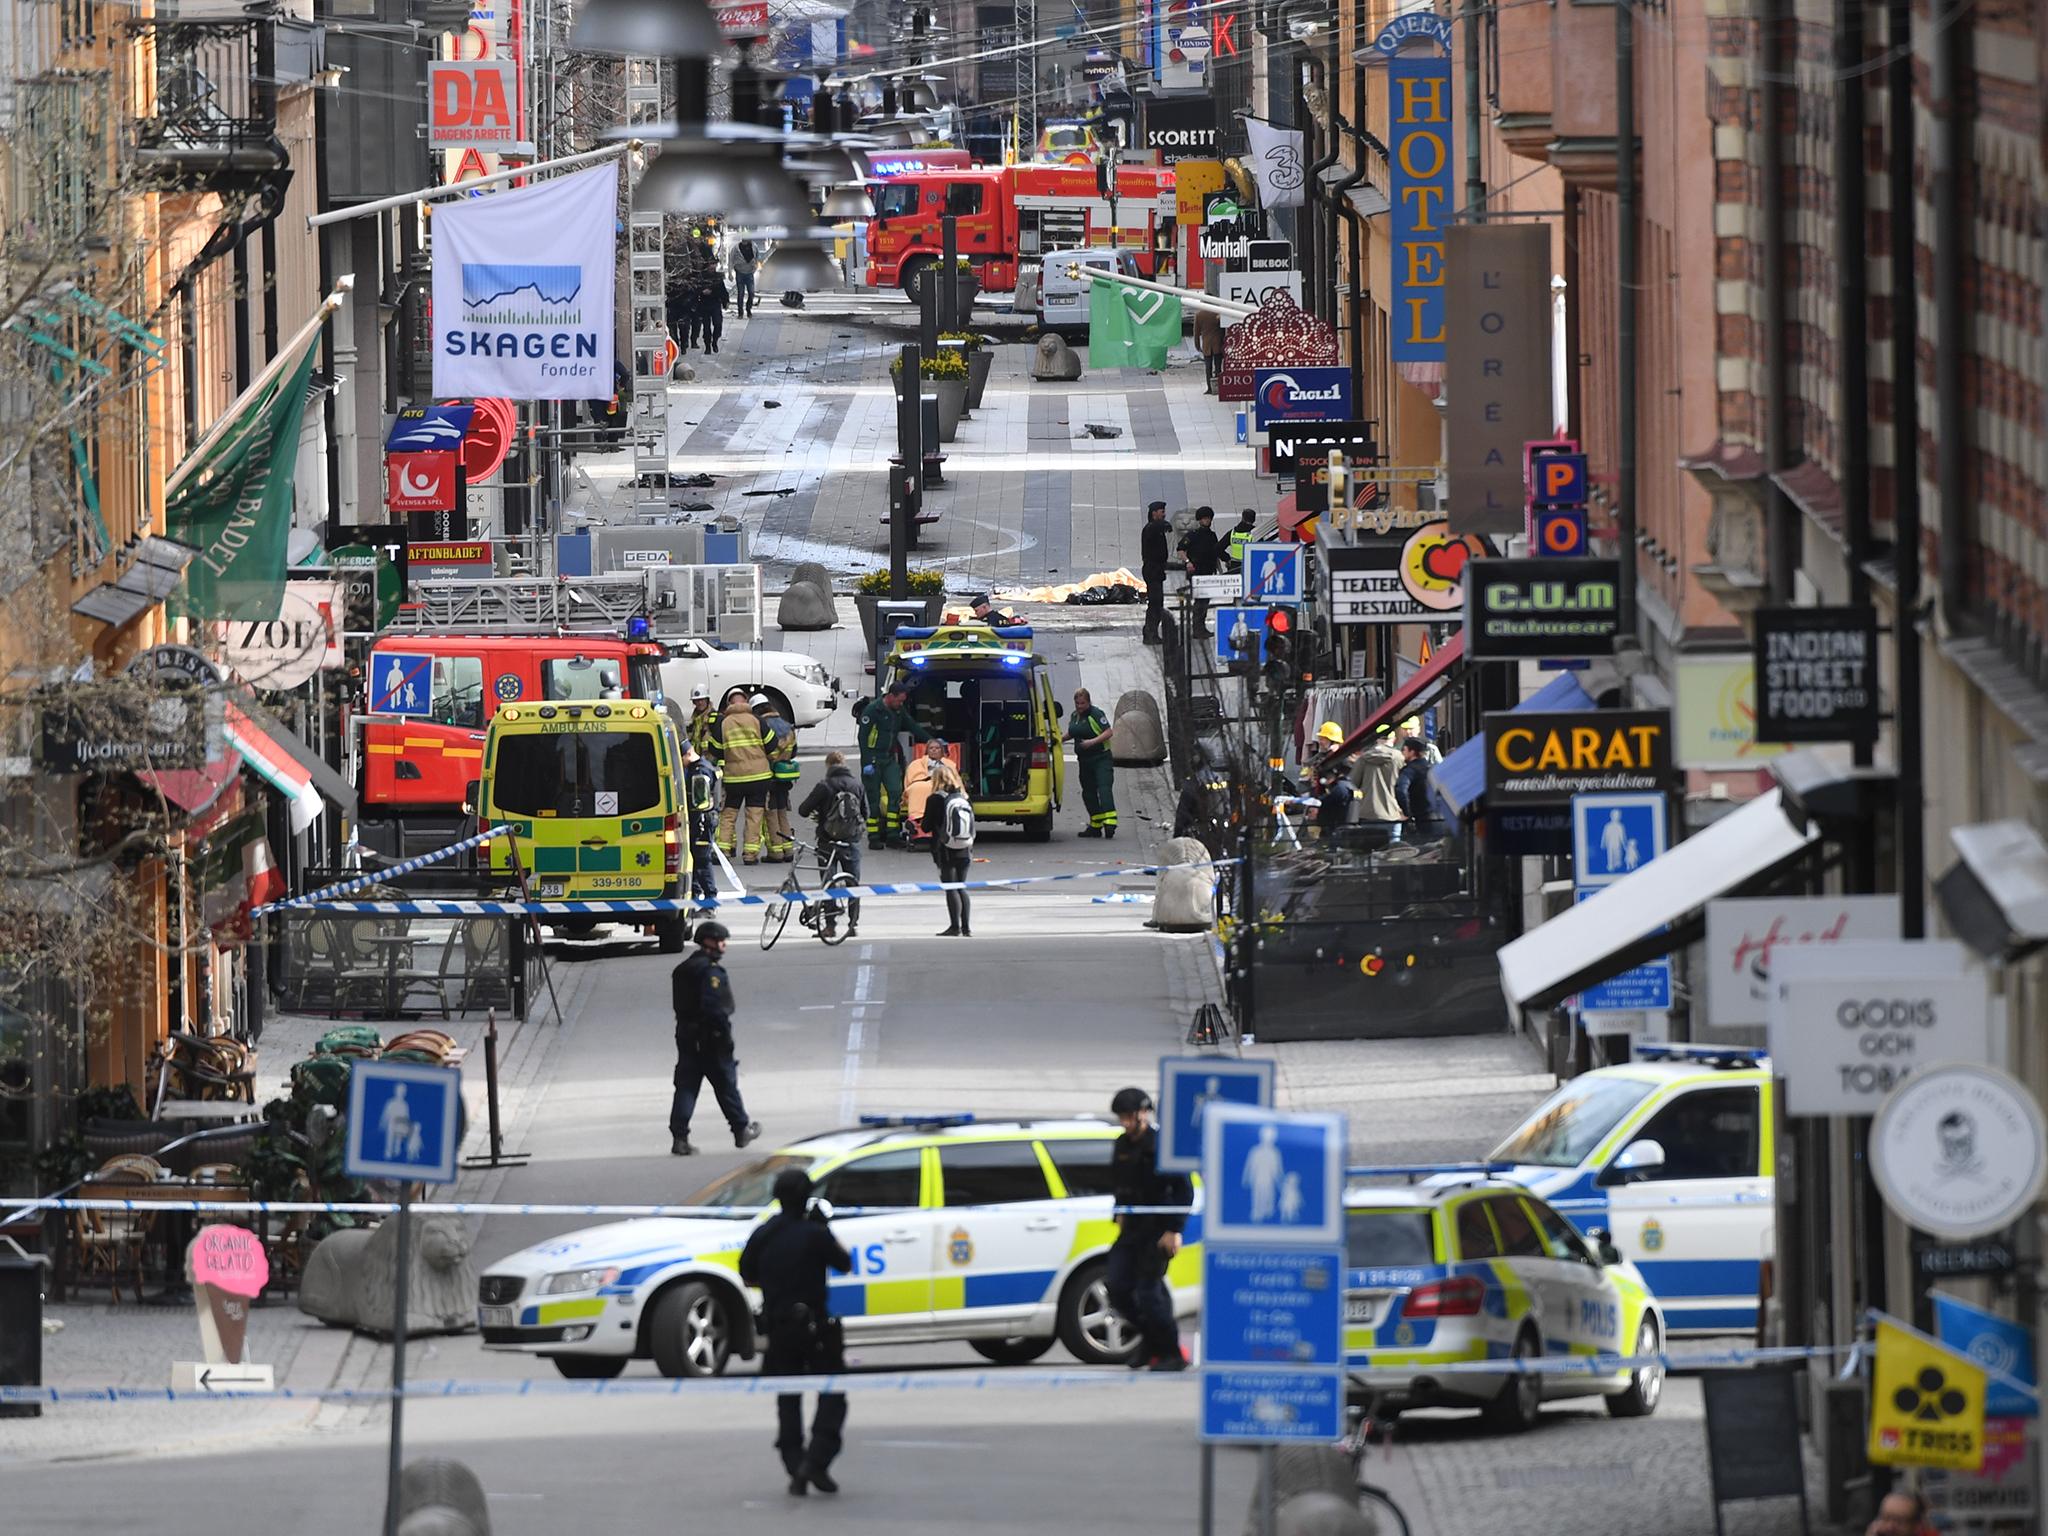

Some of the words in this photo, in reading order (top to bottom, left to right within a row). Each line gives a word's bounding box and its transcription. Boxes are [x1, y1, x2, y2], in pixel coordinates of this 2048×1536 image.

[1180, 40, 1211, 48] LONDON
[1213, 13, 1237, 57] K
[433, 69, 510, 127] DA
[434, 129, 473, 141] DAGENS
[475, 128, 511, 140] ARBETE
[1149, 130, 1216, 146] SCORETT
[1396, 78, 1448, 343] HOTEL
[1253, 259, 1268, 268] BIK
[1269, 259, 1289, 268] BOK
[445, 331, 597, 359] SKAGEN
[541, 363, 597, 376] fonder
[1222, 375, 1254, 386] DRO
[402, 410, 424, 418] ATG
[408, 547, 484, 560] AFTONBLADET
[626, 553, 667, 561] GEDA
[1485, 619, 1616, 636] Clubwear
[1766, 631, 1867, 660] INDIAN
[1766, 661, 1866, 688] STREET
[1767, 690, 1834, 718] FOOD
[541, 722, 607, 733] AMBULANS
[1495, 726, 1660, 772] CARAT
[592, 878, 642, 887] 339-9180
[1837, 999, 1937, 1029] GODIS
[1858, 1032, 1915, 1057] OCH
[1579, 1302, 1616, 1338] POLIS
[1906, 1429, 1973, 1453] TRISS
